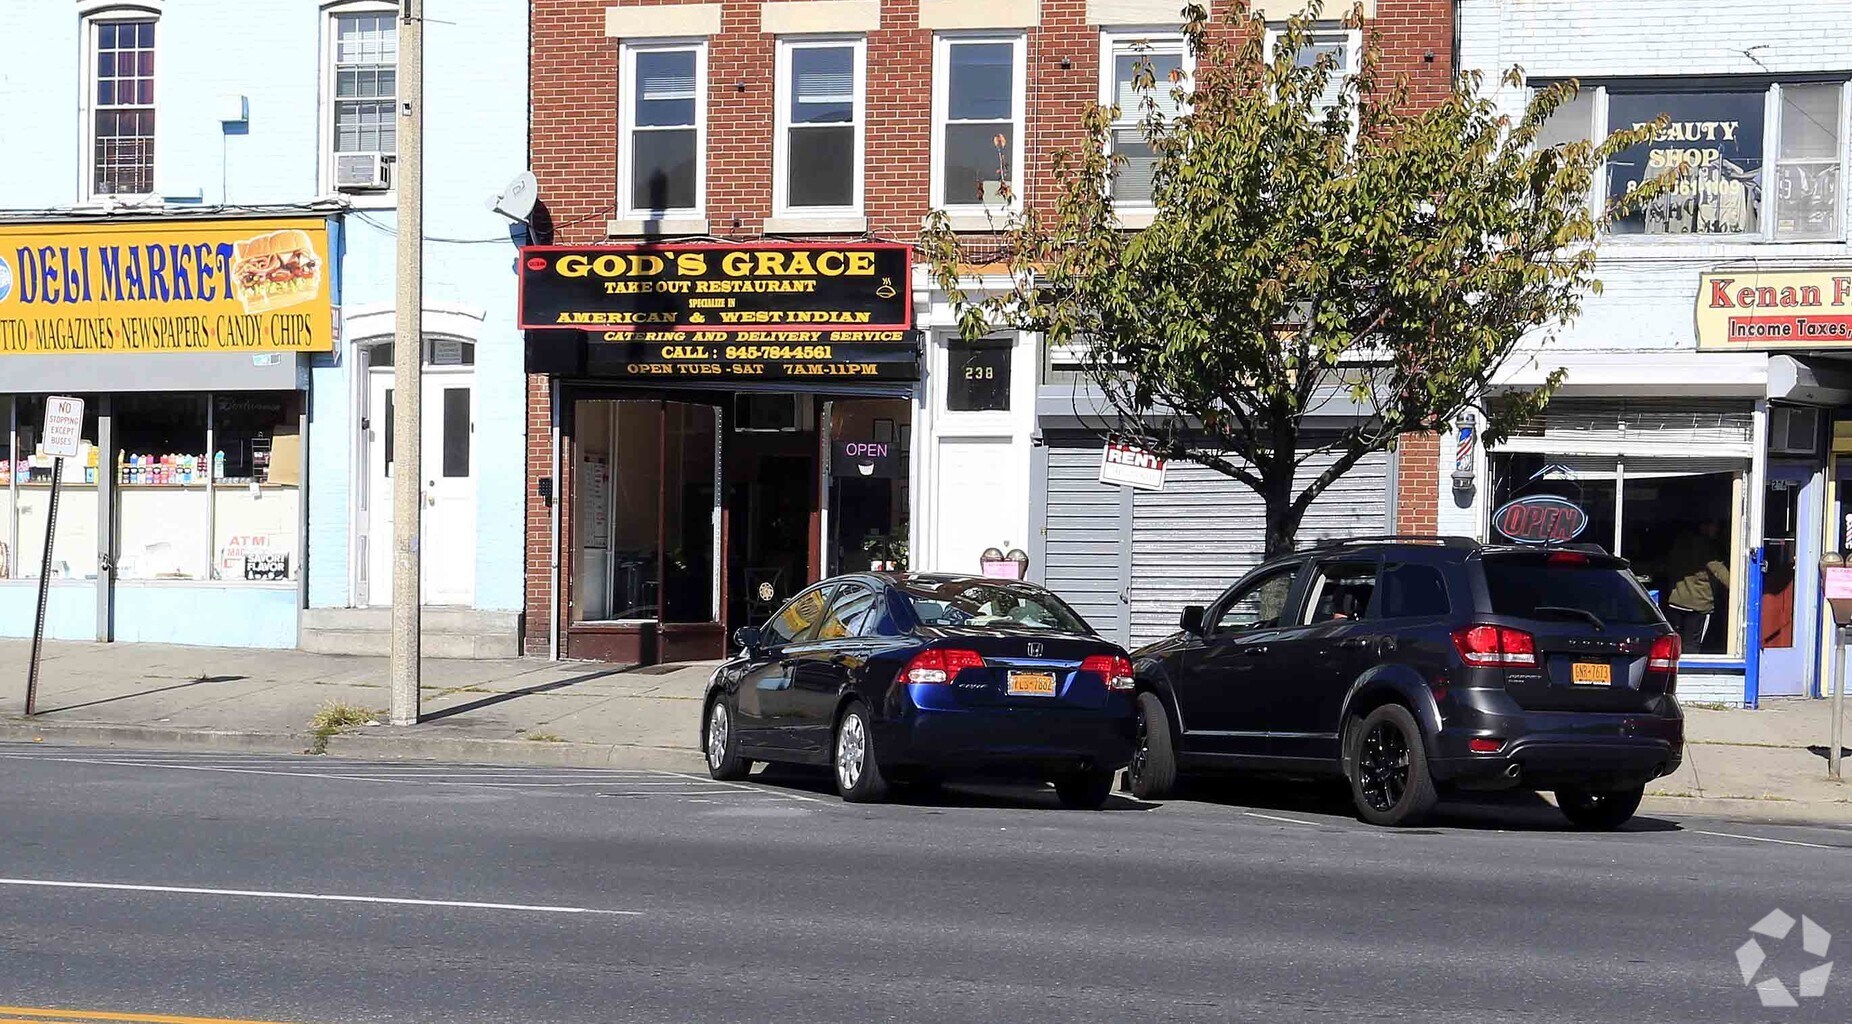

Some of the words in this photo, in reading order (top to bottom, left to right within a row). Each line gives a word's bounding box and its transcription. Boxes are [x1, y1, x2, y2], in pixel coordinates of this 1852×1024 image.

[1649, 148, 1720, 168] SHOP
[555, 251, 708, 278] GOD'S
[721, 251, 876, 277] GRACE
[16, 245, 93, 304] DELI
[99, 242, 234, 303] MARKET
[604, 280, 653, 294] TAKE
[655, 280, 692, 294] OUT
[695, 279, 817, 293] RESTAURANT
[1709, 278, 1823, 309] Kenan
[1831, 276, 1852, 307] F
[688, 297, 726, 309] SPECIALIZE
[727, 297, 736, 308] IN
[555, 311, 679, 324] AMERICAN
[688, 311, 706, 324] &
[719, 310, 784, 324] WEST
[786, 311, 872, 324] INDIAN
[34, 317, 114, 351] MAGAZINES
[120, 315, 210, 350] NEWSPAPERS
[216, 313, 263, 348] CANDY
[269, 313, 313, 347] CHIPS
[1732, 320, 1792, 337] Income
[603, 331, 687, 342] CATERING
[691, 331, 728, 342] AND
[735, 331, 822, 342] DELIVERY
[829, 330, 904, 341] SERVICE
[725, 345, 833, 360] 845-784-4561
[626, 363, 674, 374] OPEN
[783, 363, 879, 375] 7AM-11PM
[965, 366, 993, 380] 238
[58, 401, 72, 414] NO
[49, 416, 79, 425] STOPPING
[50, 426, 75, 435] EXCEPT
[50, 436, 72, 446] BUSES
[846, 442, 888, 457] OPEN
[1107, 448, 1161, 469] RENT
[1503, 504, 1578, 542] OPEN
[229, 536, 266, 546] ATM
[246, 562, 286, 572] FLAVOR
